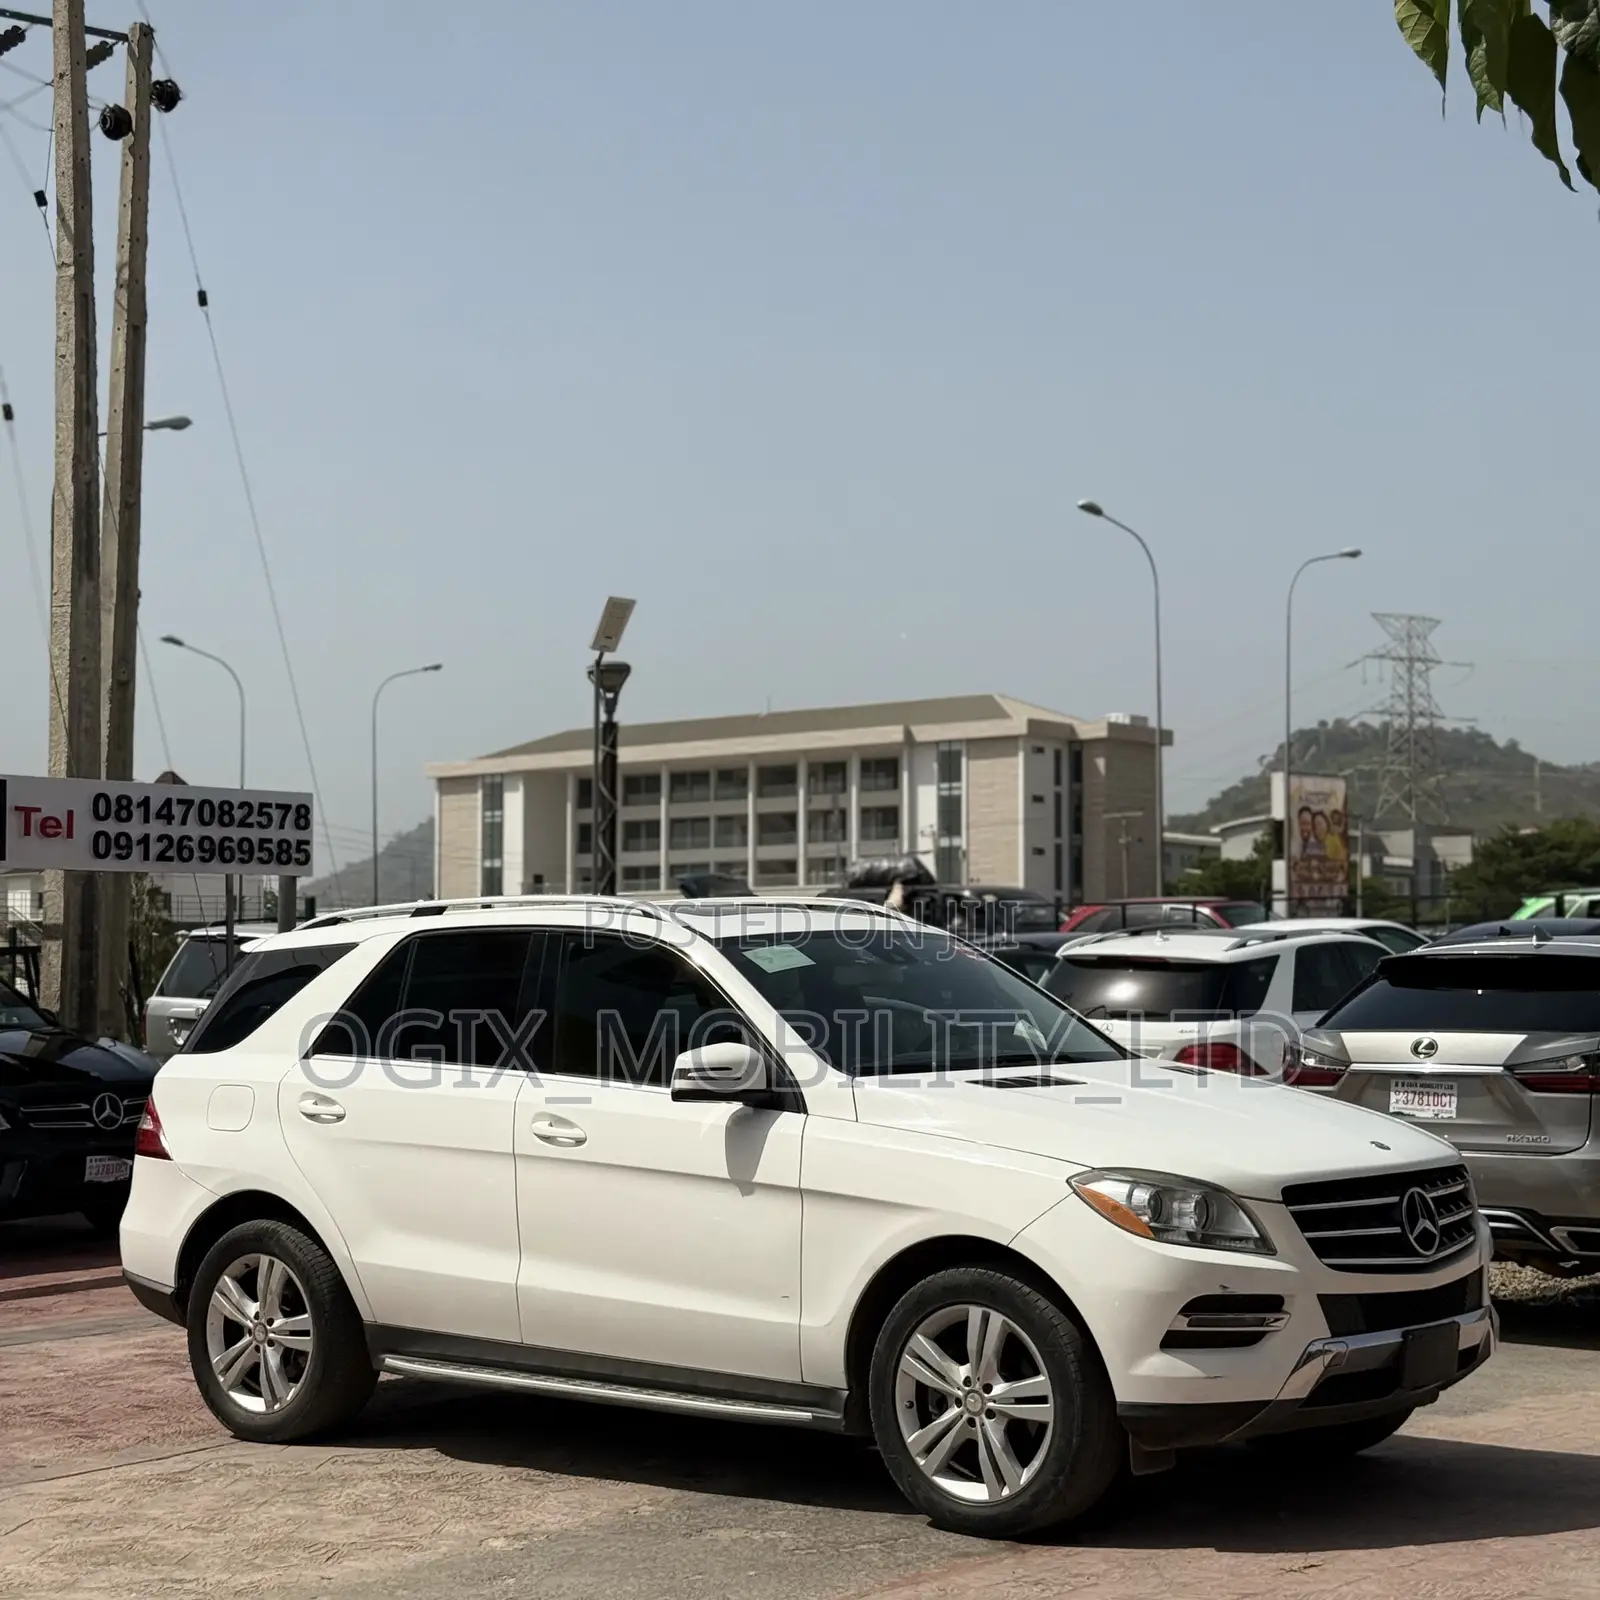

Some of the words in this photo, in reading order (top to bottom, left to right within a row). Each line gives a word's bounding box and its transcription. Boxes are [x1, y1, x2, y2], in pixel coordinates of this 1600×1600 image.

[14, 805, 75, 840] Tel
[91, 792, 312, 831] 08147082578
[91, 830, 312, 867] 09126969585
[1402, 1090, 1455, 1109] 3781DCT
